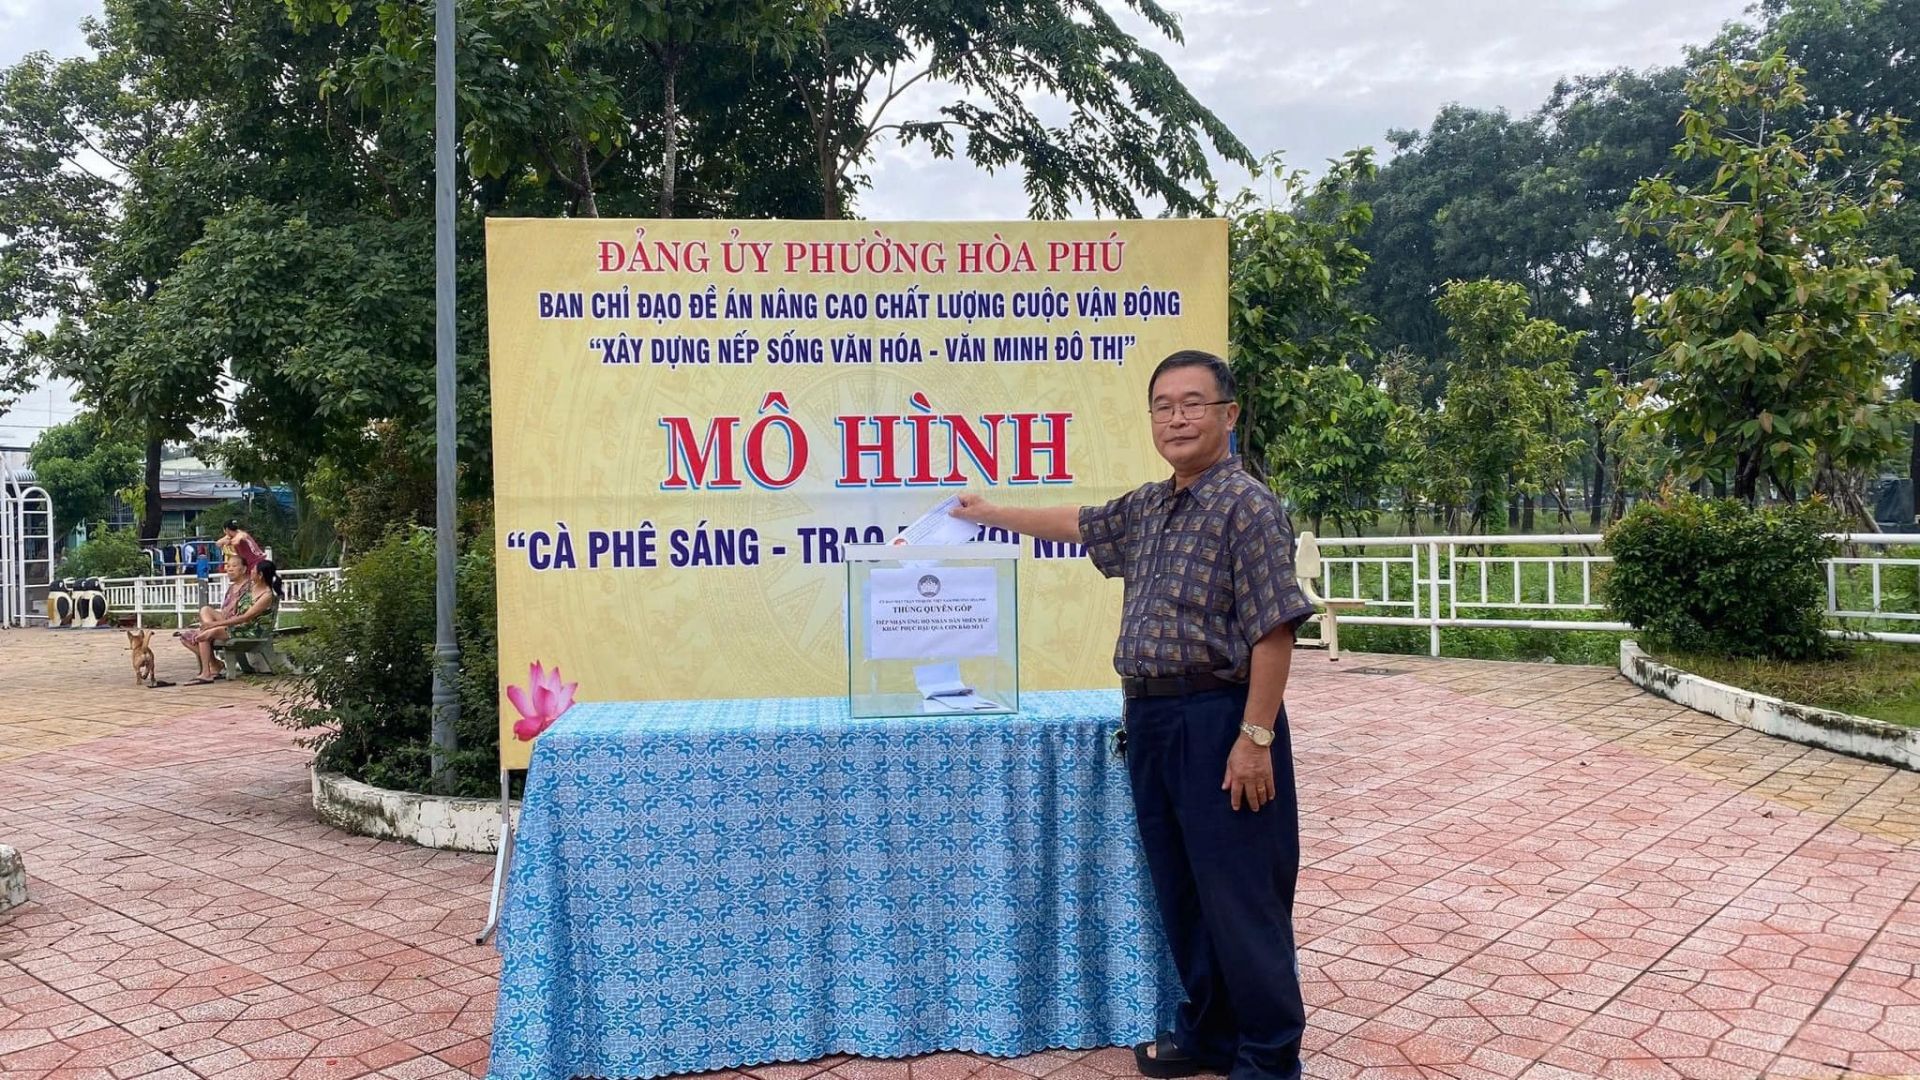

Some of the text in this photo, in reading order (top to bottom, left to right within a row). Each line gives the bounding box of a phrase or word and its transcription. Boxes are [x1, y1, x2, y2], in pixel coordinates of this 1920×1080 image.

[599, 228, 1126, 274] ĐẢNG ỦY PHƯỜNG HÒA PHÚ
[539, 284, 1180, 325] BAN CHỈ ĐẠO ĐỀ ÁN NÂNG CAO CHẤT LƯỢNG CUỘC VẬN ĐỘNG
[589, 332, 643, 364] “XÂY
[651, 335, 710, 370] DỰNG
[718, 329, 760, 364] NẾP
[767, 329, 823, 364] SỐNG
[830, 333, 872, 363] VĂN
[880, 332, 923, 363] HÓA
[944, 333, 986, 362] VĂN
[993, 336, 1048, 362] MINH
[1054, 330, 1083, 361] ĐÔ
[1089, 335, 1135, 366] THỊ”
[659, 390, 1074, 492] MÔ HÌNH
[507, 522, 576, 570] “CÀ
[588, 520, 657, 568] PHÊ
[670, 520, 759, 567] SÁNG
